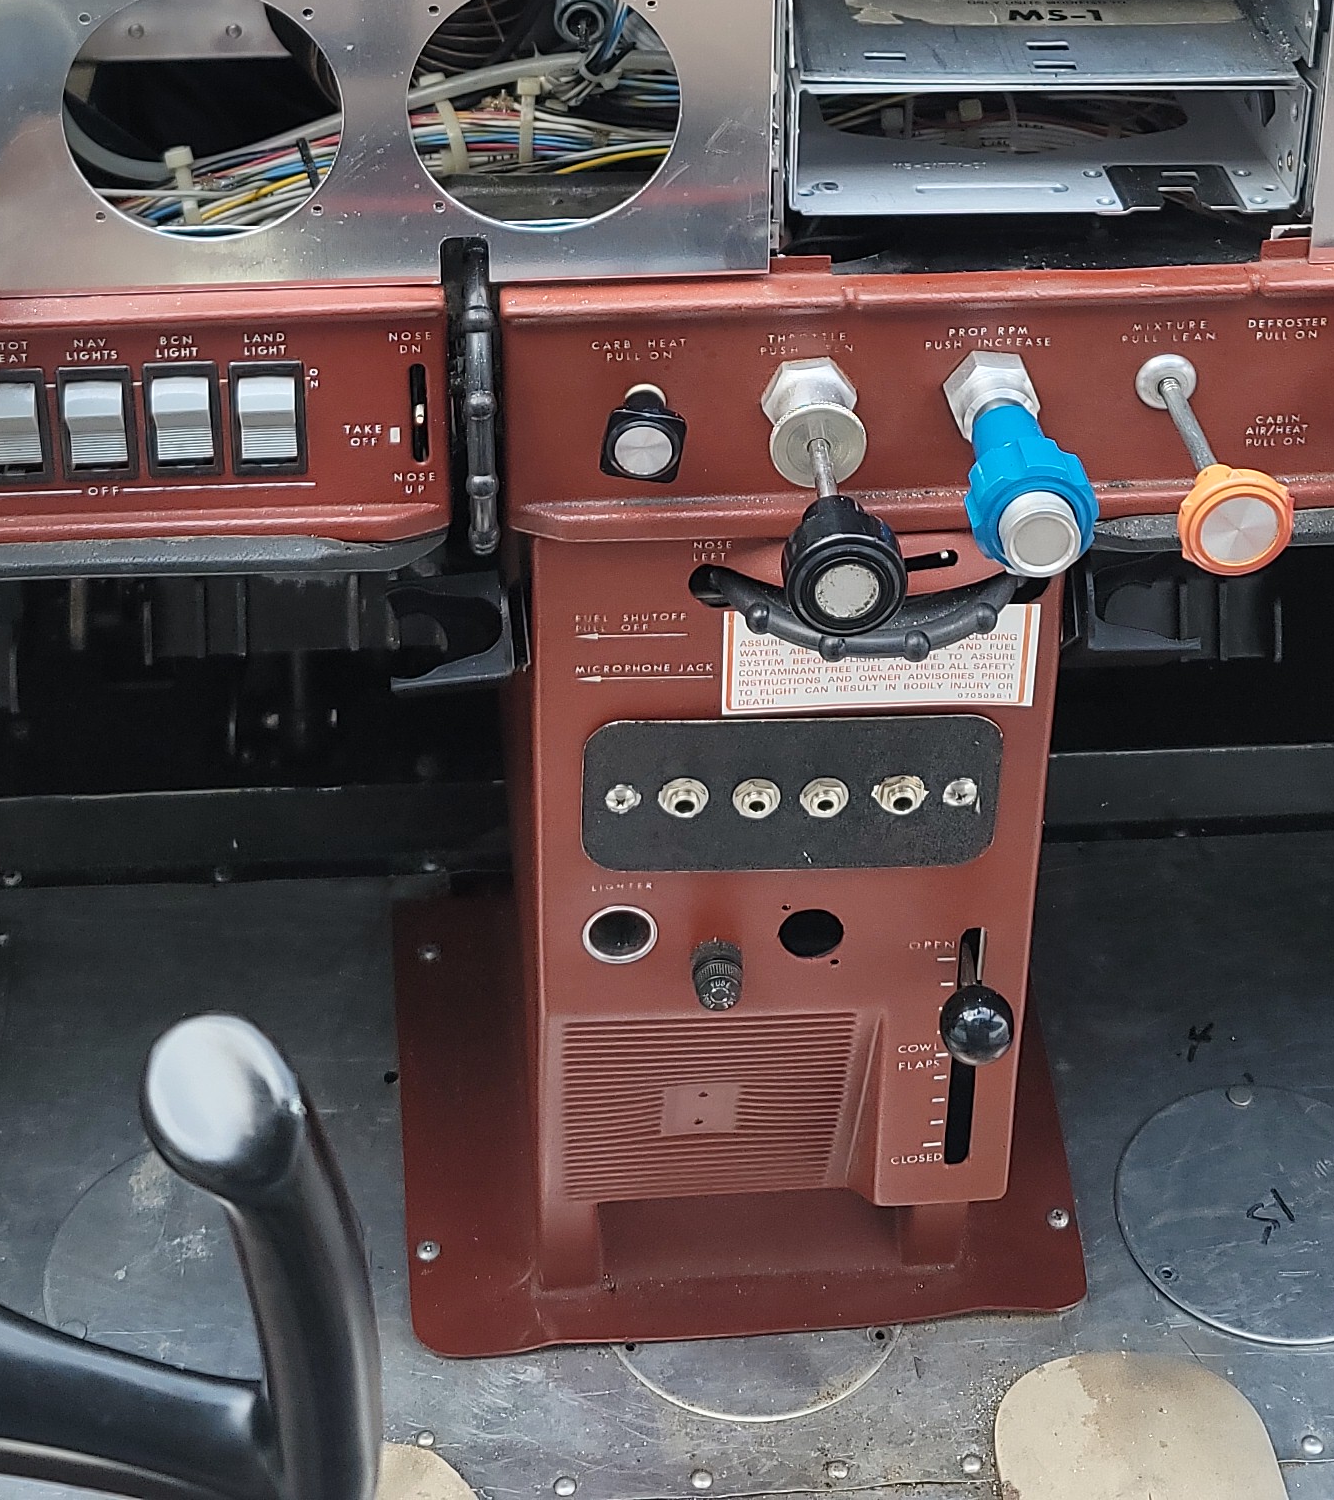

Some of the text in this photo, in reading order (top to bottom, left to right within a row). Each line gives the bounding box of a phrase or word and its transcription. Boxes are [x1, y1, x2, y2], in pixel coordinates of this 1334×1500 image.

[1132, 320, 1209, 331] MIXTURE
[1248, 317, 1329, 329] DEFROSTER
[388, 331, 432, 342] NOSE
[948, 325, 1030, 338] PROP RPM
[1122, 331, 1218, 343] PULL LEAN
[1256, 329, 1318, 342] PULL ON
[73, 338, 107, 349] NAV
[159, 335, 194, 346] BCN
[243, 332, 286, 344] LAND
[591, 338, 688, 350] CARB HEAT
[925, 337, 1053, 350] PUSH INCREASE
[155, 347, 199, 359] LIGHT
[244, 344, 288, 357] LIGHT
[399, 344, 422, 354] DN
[66, 349, 119, 362] LIGHTS
[606, 350, 673, 362] PULL ON
[1255, 414, 1301, 425] CABIN
[343, 424, 383, 435] TAKE
[1245, 424, 1309, 437] AIR/HEAT
[350, 437, 378, 447] OFF
[1245, 436, 1307, 448] PULL ON
[393, 472, 437, 483] NOSE
[88, 486, 120, 496] OFF
[404, 484, 425, 494] UP
[693, 540, 733, 550] NOSE
[693, 552, 727, 563] LEFT
[622, 612, 689, 622] SHUTOFF
[620, 624, 650, 632] OFF
[968, 633, 1018, 641] CLUDING
[789, 647, 812, 655] ARE
[957, 643, 983, 651] AND
[989, 643, 1016, 651] FUEL
[739, 657, 785, 667] SYSTEM
[970, 652, 1016, 661] ASSURE
[575, 662, 714, 674] MICROPHONE JACK
[738, 662, 1015, 678] CONTAMINANT FREE FUEL AND HEED ALL SAFETY
[738, 672, 1014, 687] INSTRUCTIONS AND OWNER ADVISORIES PRIOR
[738, 681, 1014, 697] TO FLIGHT CAN RESULT IN BODILY INJURY OR
[738, 697, 778, 707] DEATH.
[591, 882, 654, 893] LIGHTER
[909, 940, 956, 950] OPEN
[898, 1060, 941, 1072] FLAPS
[890, 1153, 943, 1165] CLOSED
